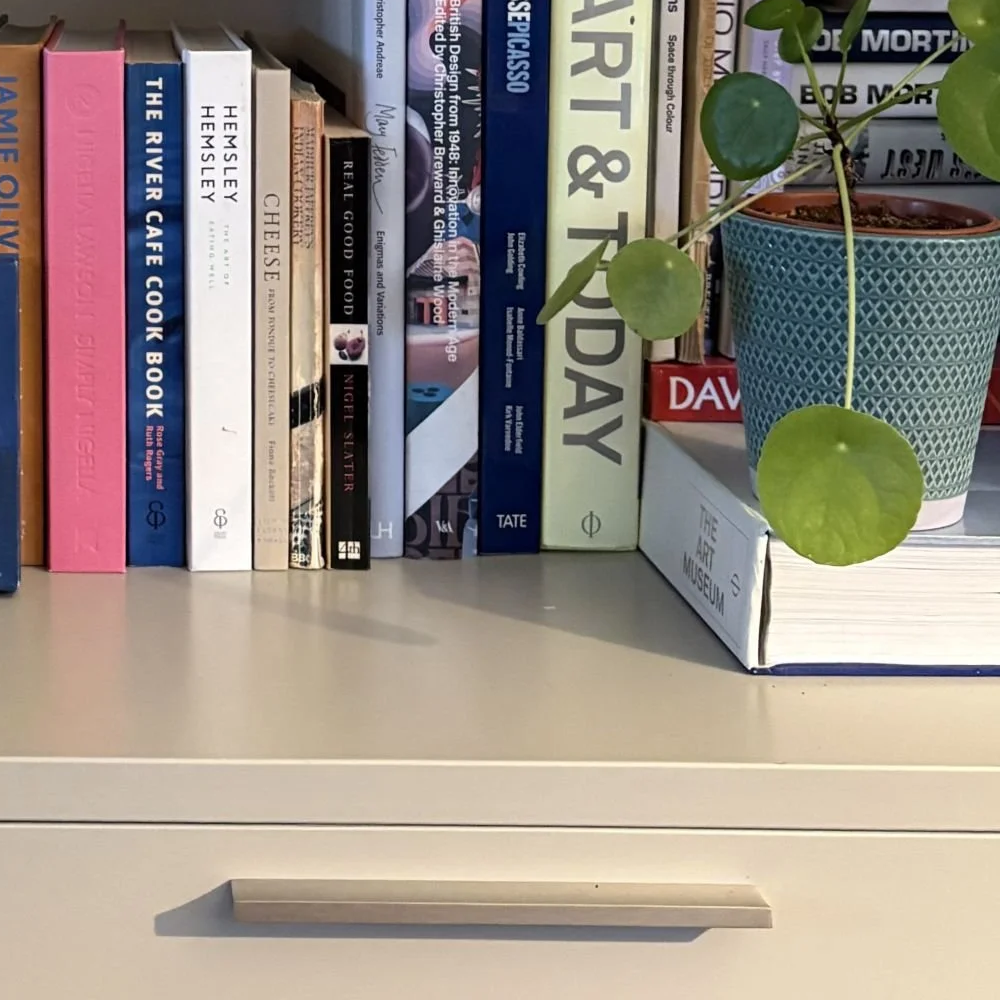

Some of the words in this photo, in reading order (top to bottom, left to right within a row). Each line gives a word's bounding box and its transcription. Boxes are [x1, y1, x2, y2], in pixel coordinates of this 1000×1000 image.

[375, 41, 384, 79] Andreae
[432, 45, 446, 60] by
[447, 45, 461, 91] Design
[666, 35, 677, 62] Space
[145, 77, 162, 121] THE
[664, 64, 676, 101] through
[431, 63, 446, 144] Christopher
[449, 94, 461, 126] from
[665, 104, 675, 134] Colour
[145, 131, 162, 201] RIVER
[200, 105, 215, 203] HEMSLEY
[223, 105, 238, 203] HEMSLEY
[449, 129, 461, 164] 1948:
[343, 160, 354, 203] REAL
[434, 147, 446, 202] Breward
[567, 145, 631, 199] &
[434, 206, 445, 216] &
[448, 167, 460, 237] Innovation
[145, 210, 164, 267] CAFE
[263, 193, 281, 283] CHEESE
[343, 211, 354, 261] GOOD
[375, 231, 386, 268] Enigmas
[433, 219, 445, 281] Ghislaine
[448, 240, 459, 253] in
[376, 271, 385, 288] and
[448, 256, 459, 277] the
[145, 275, 164, 342] COOK
[343, 277, 354, 316] FOOD
[376, 292, 386, 336] Variations
[433, 285, 444, 324] Wood
[447, 281, 459, 331] Modern
[445, 336, 458, 362] Age
[145, 351, 164, 419] BOOK
[343, 374, 354, 423] NIGEL
[145, 425, 154, 446] Ruth
[156, 425, 164, 447] Rose
[144, 448, 153, 481] Rogers
[155, 450, 164, 470] Gray
[343, 432, 355, 492] SLATER
[156, 473, 164, 490] and
[497, 515, 527, 528] TATE
[700, 504, 719, 541] THE
[695, 534, 716, 570] ART
[682, 554, 725, 617] MUSEUM
